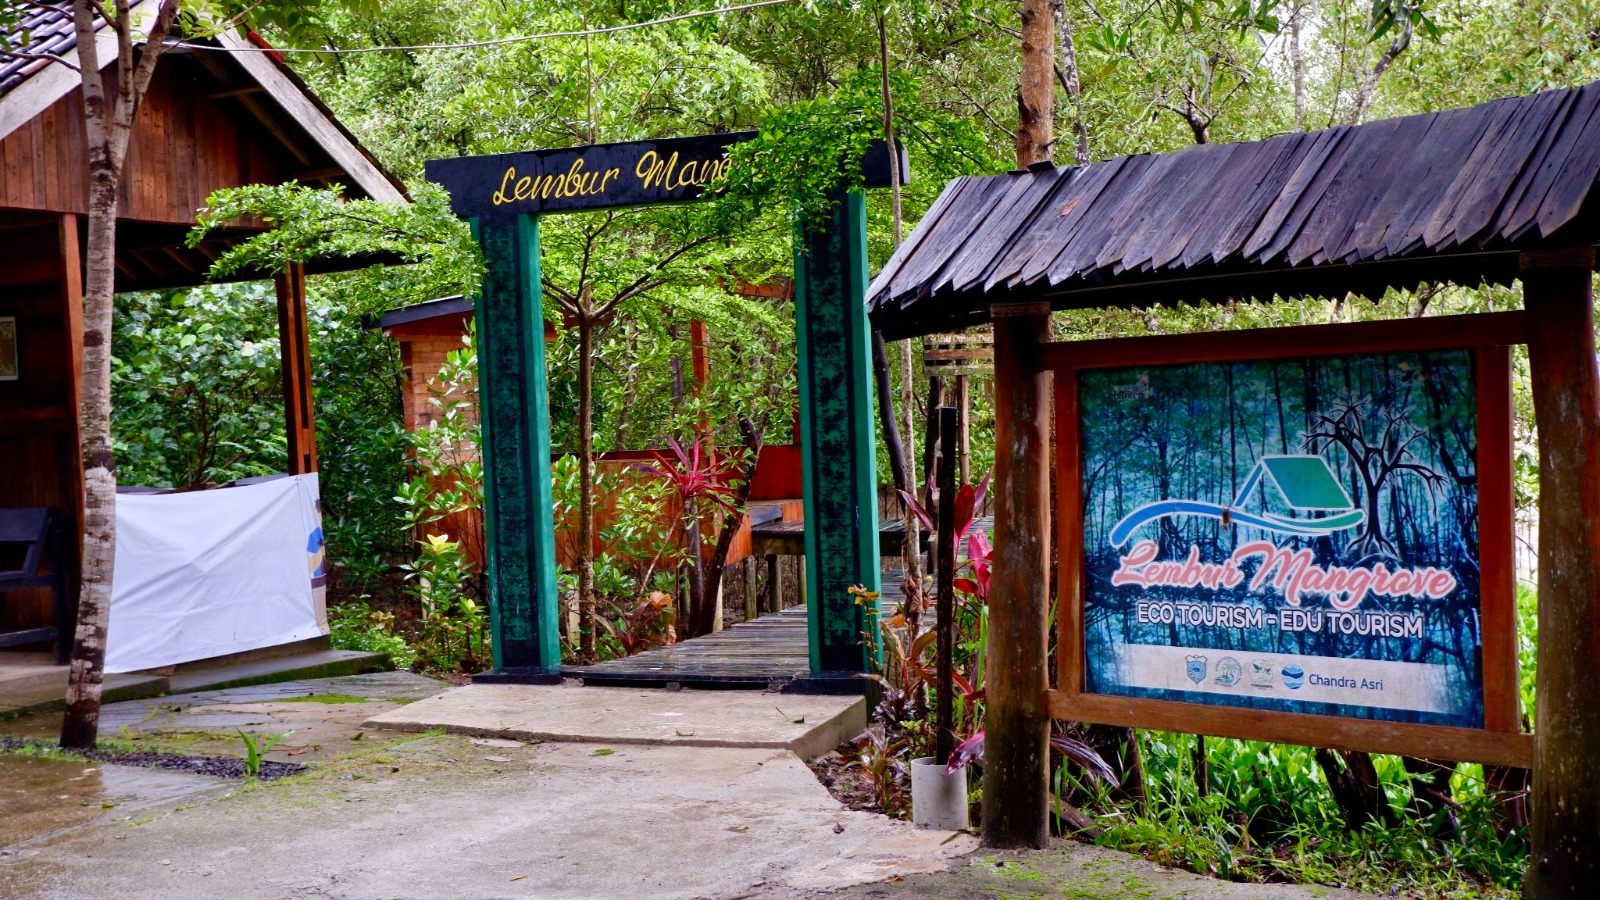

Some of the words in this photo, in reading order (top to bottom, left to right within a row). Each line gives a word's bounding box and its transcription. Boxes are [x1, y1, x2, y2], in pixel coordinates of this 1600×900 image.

[492, 157, 620, 206] Lembur
[635, 150, 733, 193] Mang
[1112, 542, 1243, 588] Lembur
[1235, 542, 1456, 609] Mangrove
[1138, 602, 1174, 624] ECO
[1178, 604, 1263, 629] TOURISM
[1280, 609, 1323, 633] EDU
[1330, 611, 1423, 639] TOURISM
[1308, 673, 1357, 689] Chandra
[1360, 677, 1384, 691] Asri
